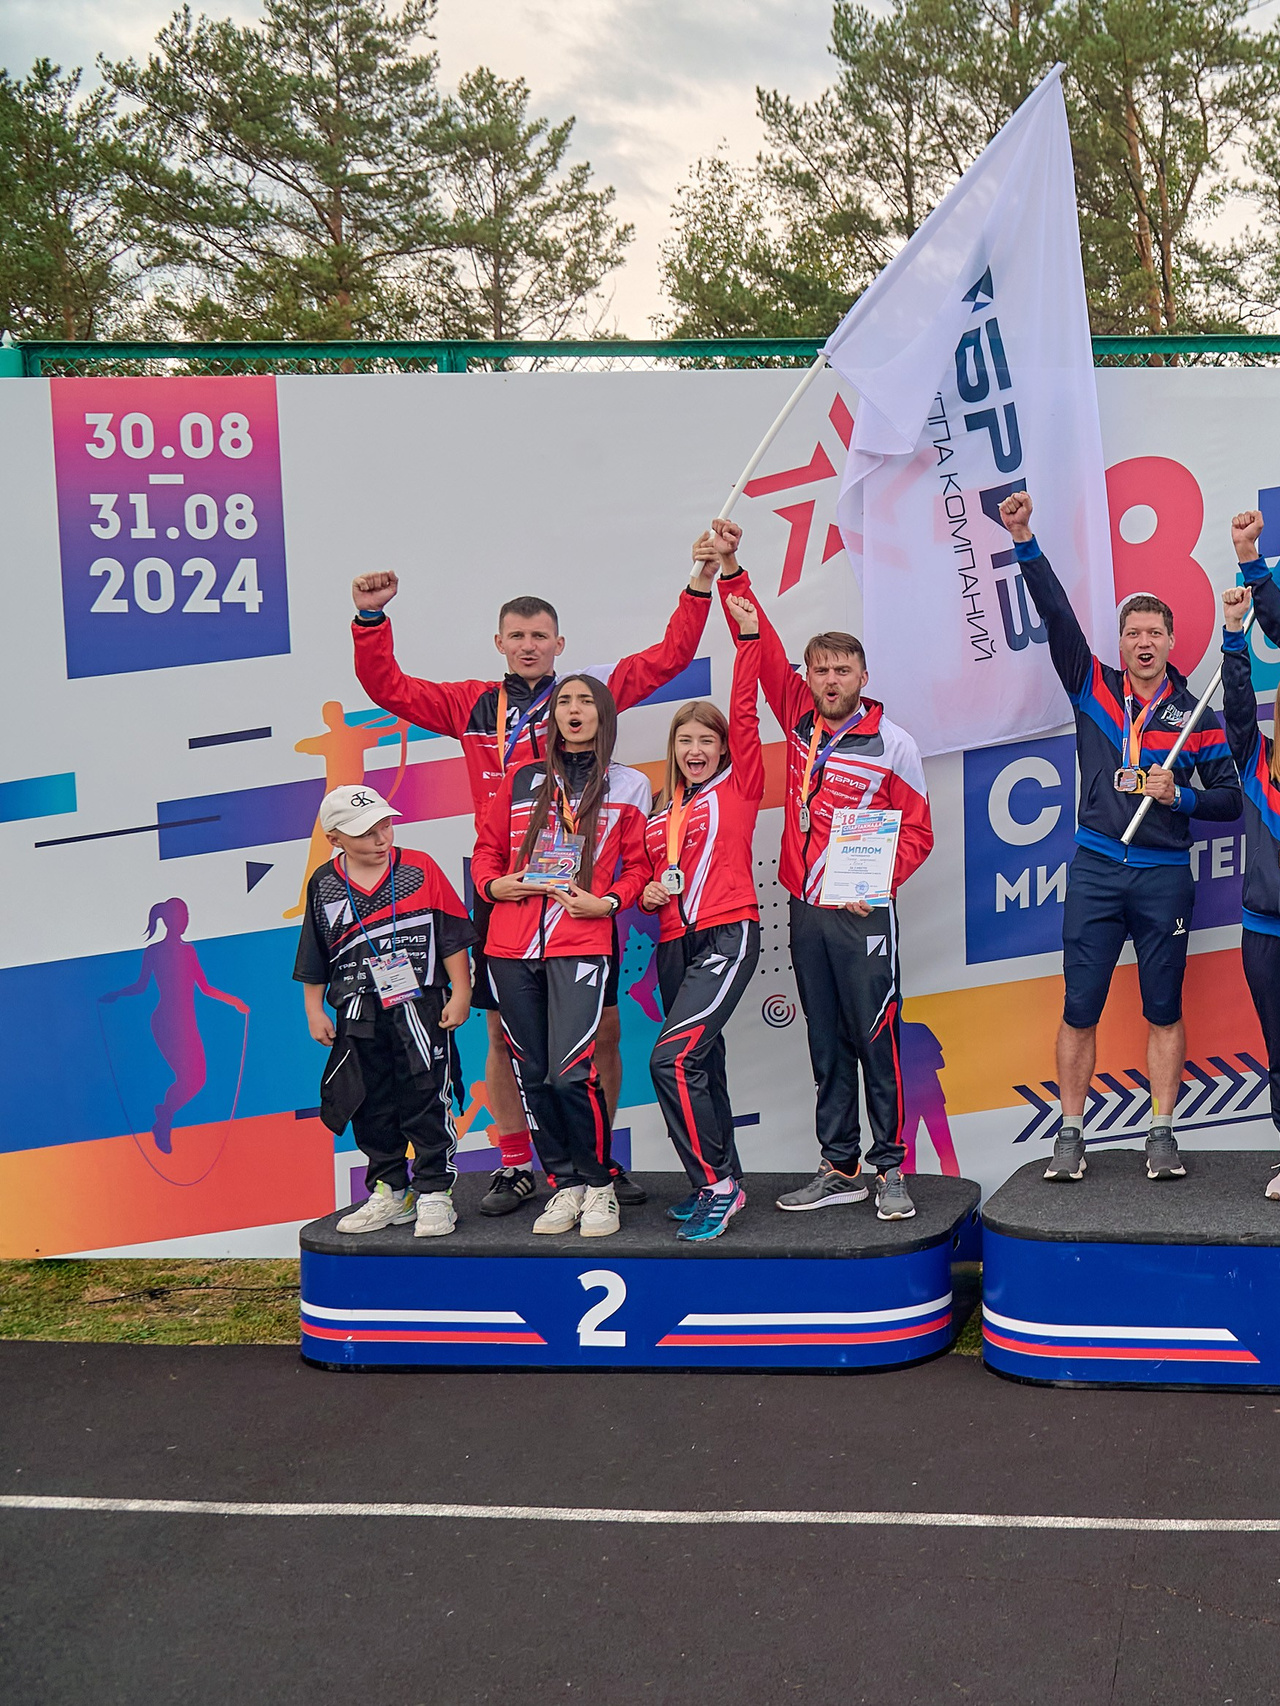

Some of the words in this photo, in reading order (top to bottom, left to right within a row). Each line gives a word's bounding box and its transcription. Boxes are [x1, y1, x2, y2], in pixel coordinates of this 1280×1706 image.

[84, 411, 254, 460] 30.08
[927, 391, 954, 466] ППА
[89, 493, 259, 541] 31.08
[88, 556, 264, 614] 2024
[939, 472, 997, 662] КОМПАНИЙ
[835, 776, 867, 790] БРИЗ
[841, 813, 856, 826] 18
[555, 857, 575, 878] 2
[841, 846, 881, 855] ДИПЛОМ
[577, 1269, 628, 1348] 2
